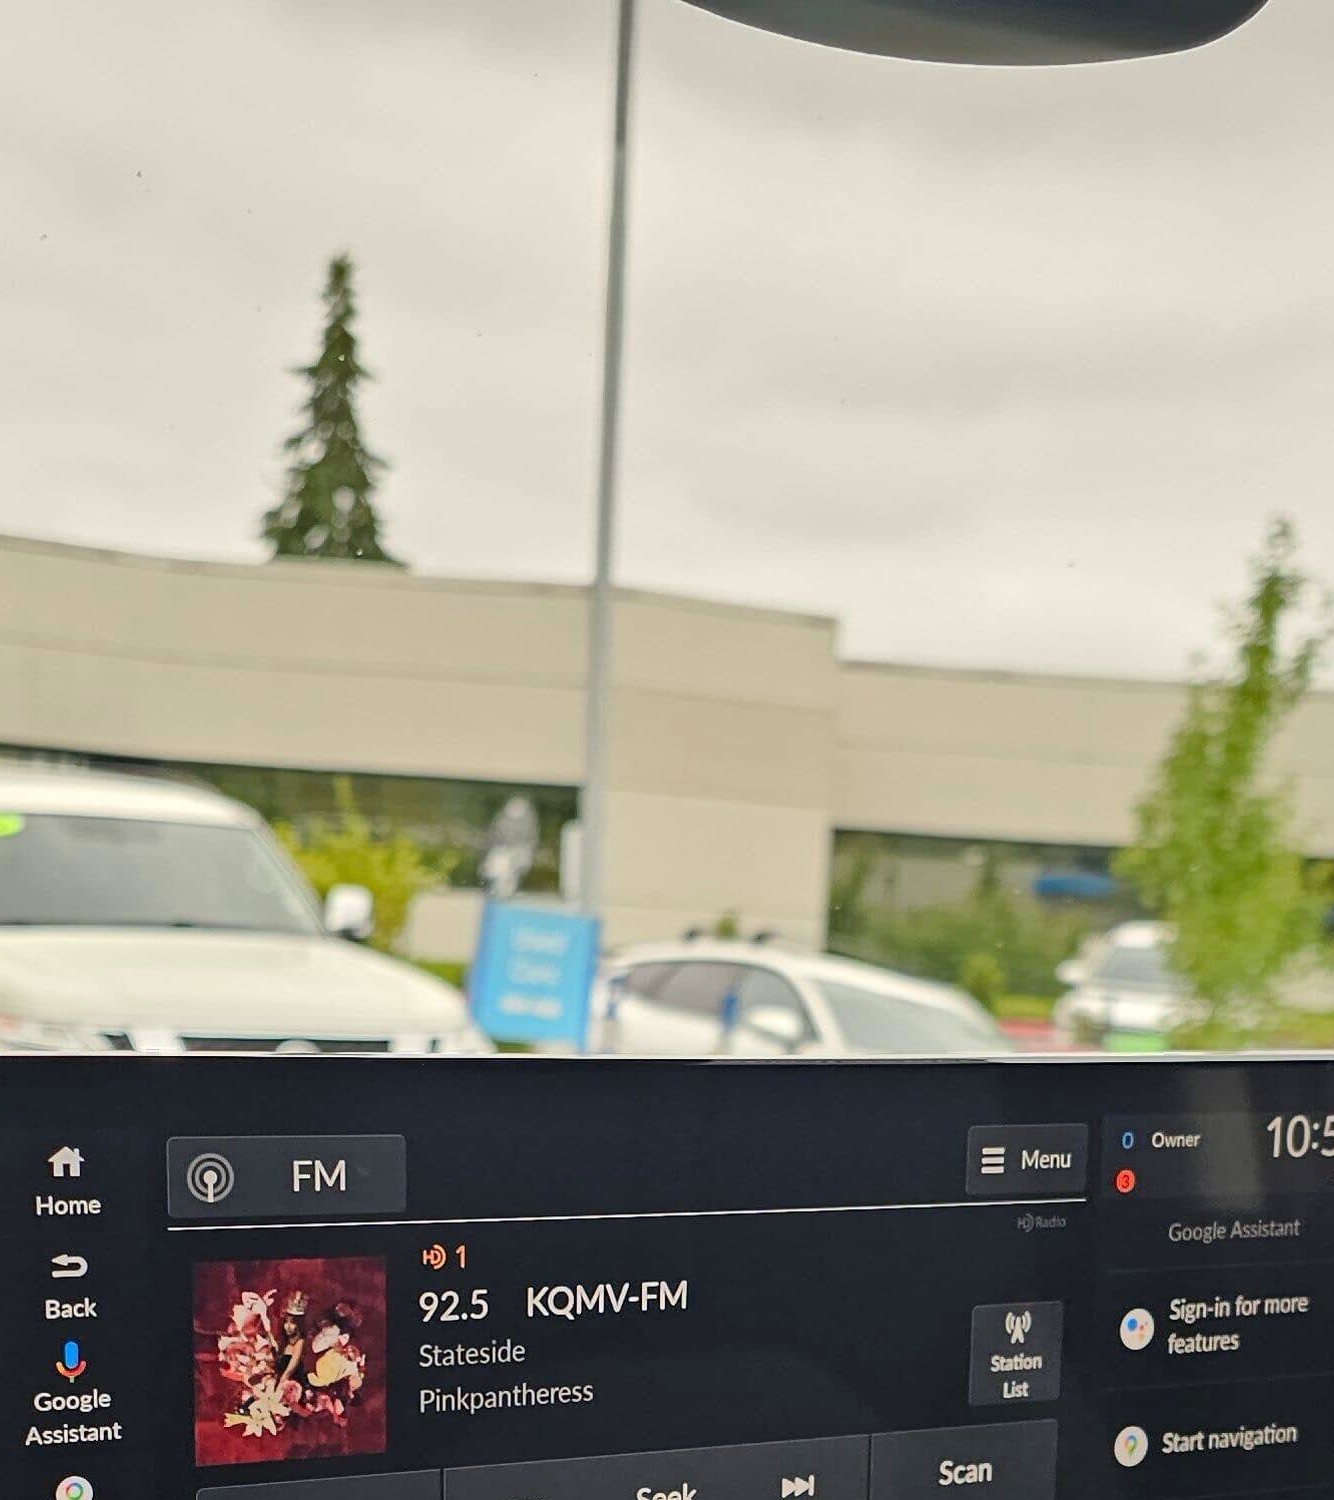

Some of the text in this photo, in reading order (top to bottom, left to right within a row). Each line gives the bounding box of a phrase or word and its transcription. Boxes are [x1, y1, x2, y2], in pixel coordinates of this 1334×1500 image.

[1151, 1131, 1201, 1148] Owner
[1021, 1149, 1072, 1170] Menu
[293, 1159, 346, 1192] FM
[35, 1195, 102, 1216] Home
[1168, 1219, 1301, 1244] Google Assistant
[455, 1245, 466, 1269] 1
[45, 1297, 98, 1320] Back
[419, 1279, 688, 1323] 92.5 KQMV-FM
[1169, 1294, 1309, 1325] Sign-in for more
[419, 1338, 526, 1368] Stateside
[1167, 1332, 1240, 1355] features
[990, 1352, 1043, 1373] Station
[33, 1387, 112, 1413] Google
[420, 1382, 594, 1415] Pinkpantheress
[1002, 1380, 1030, 1399] List
[25, 1422, 123, 1447] Assistant
[1161, 1422, 1298, 1454] Start navigation
[938, 1460, 993, 1486] Scan
